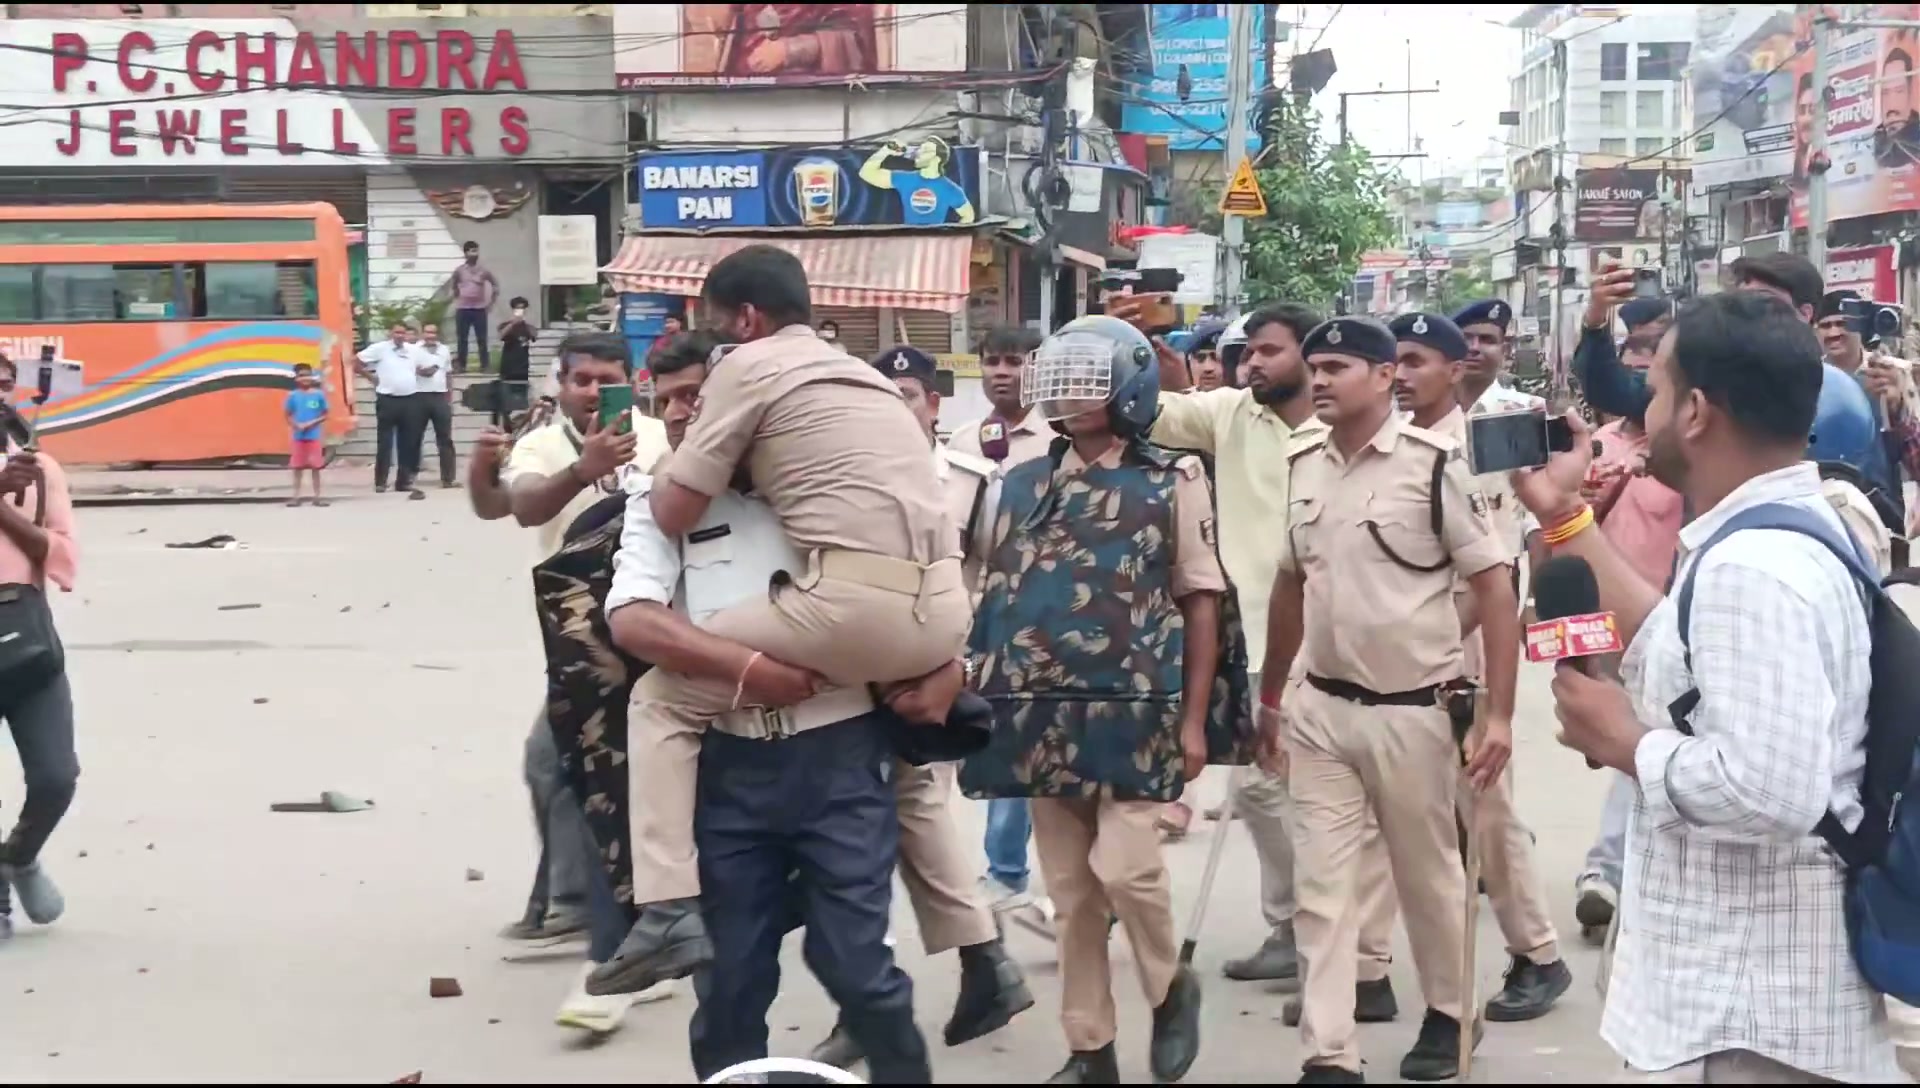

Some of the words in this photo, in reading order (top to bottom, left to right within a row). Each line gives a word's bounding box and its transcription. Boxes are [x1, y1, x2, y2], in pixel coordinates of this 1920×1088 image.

[56, 106, 530, 156] JEWELLERS
[643, 165, 759, 190] BANARSI
[678, 196, 733, 221] PAN
